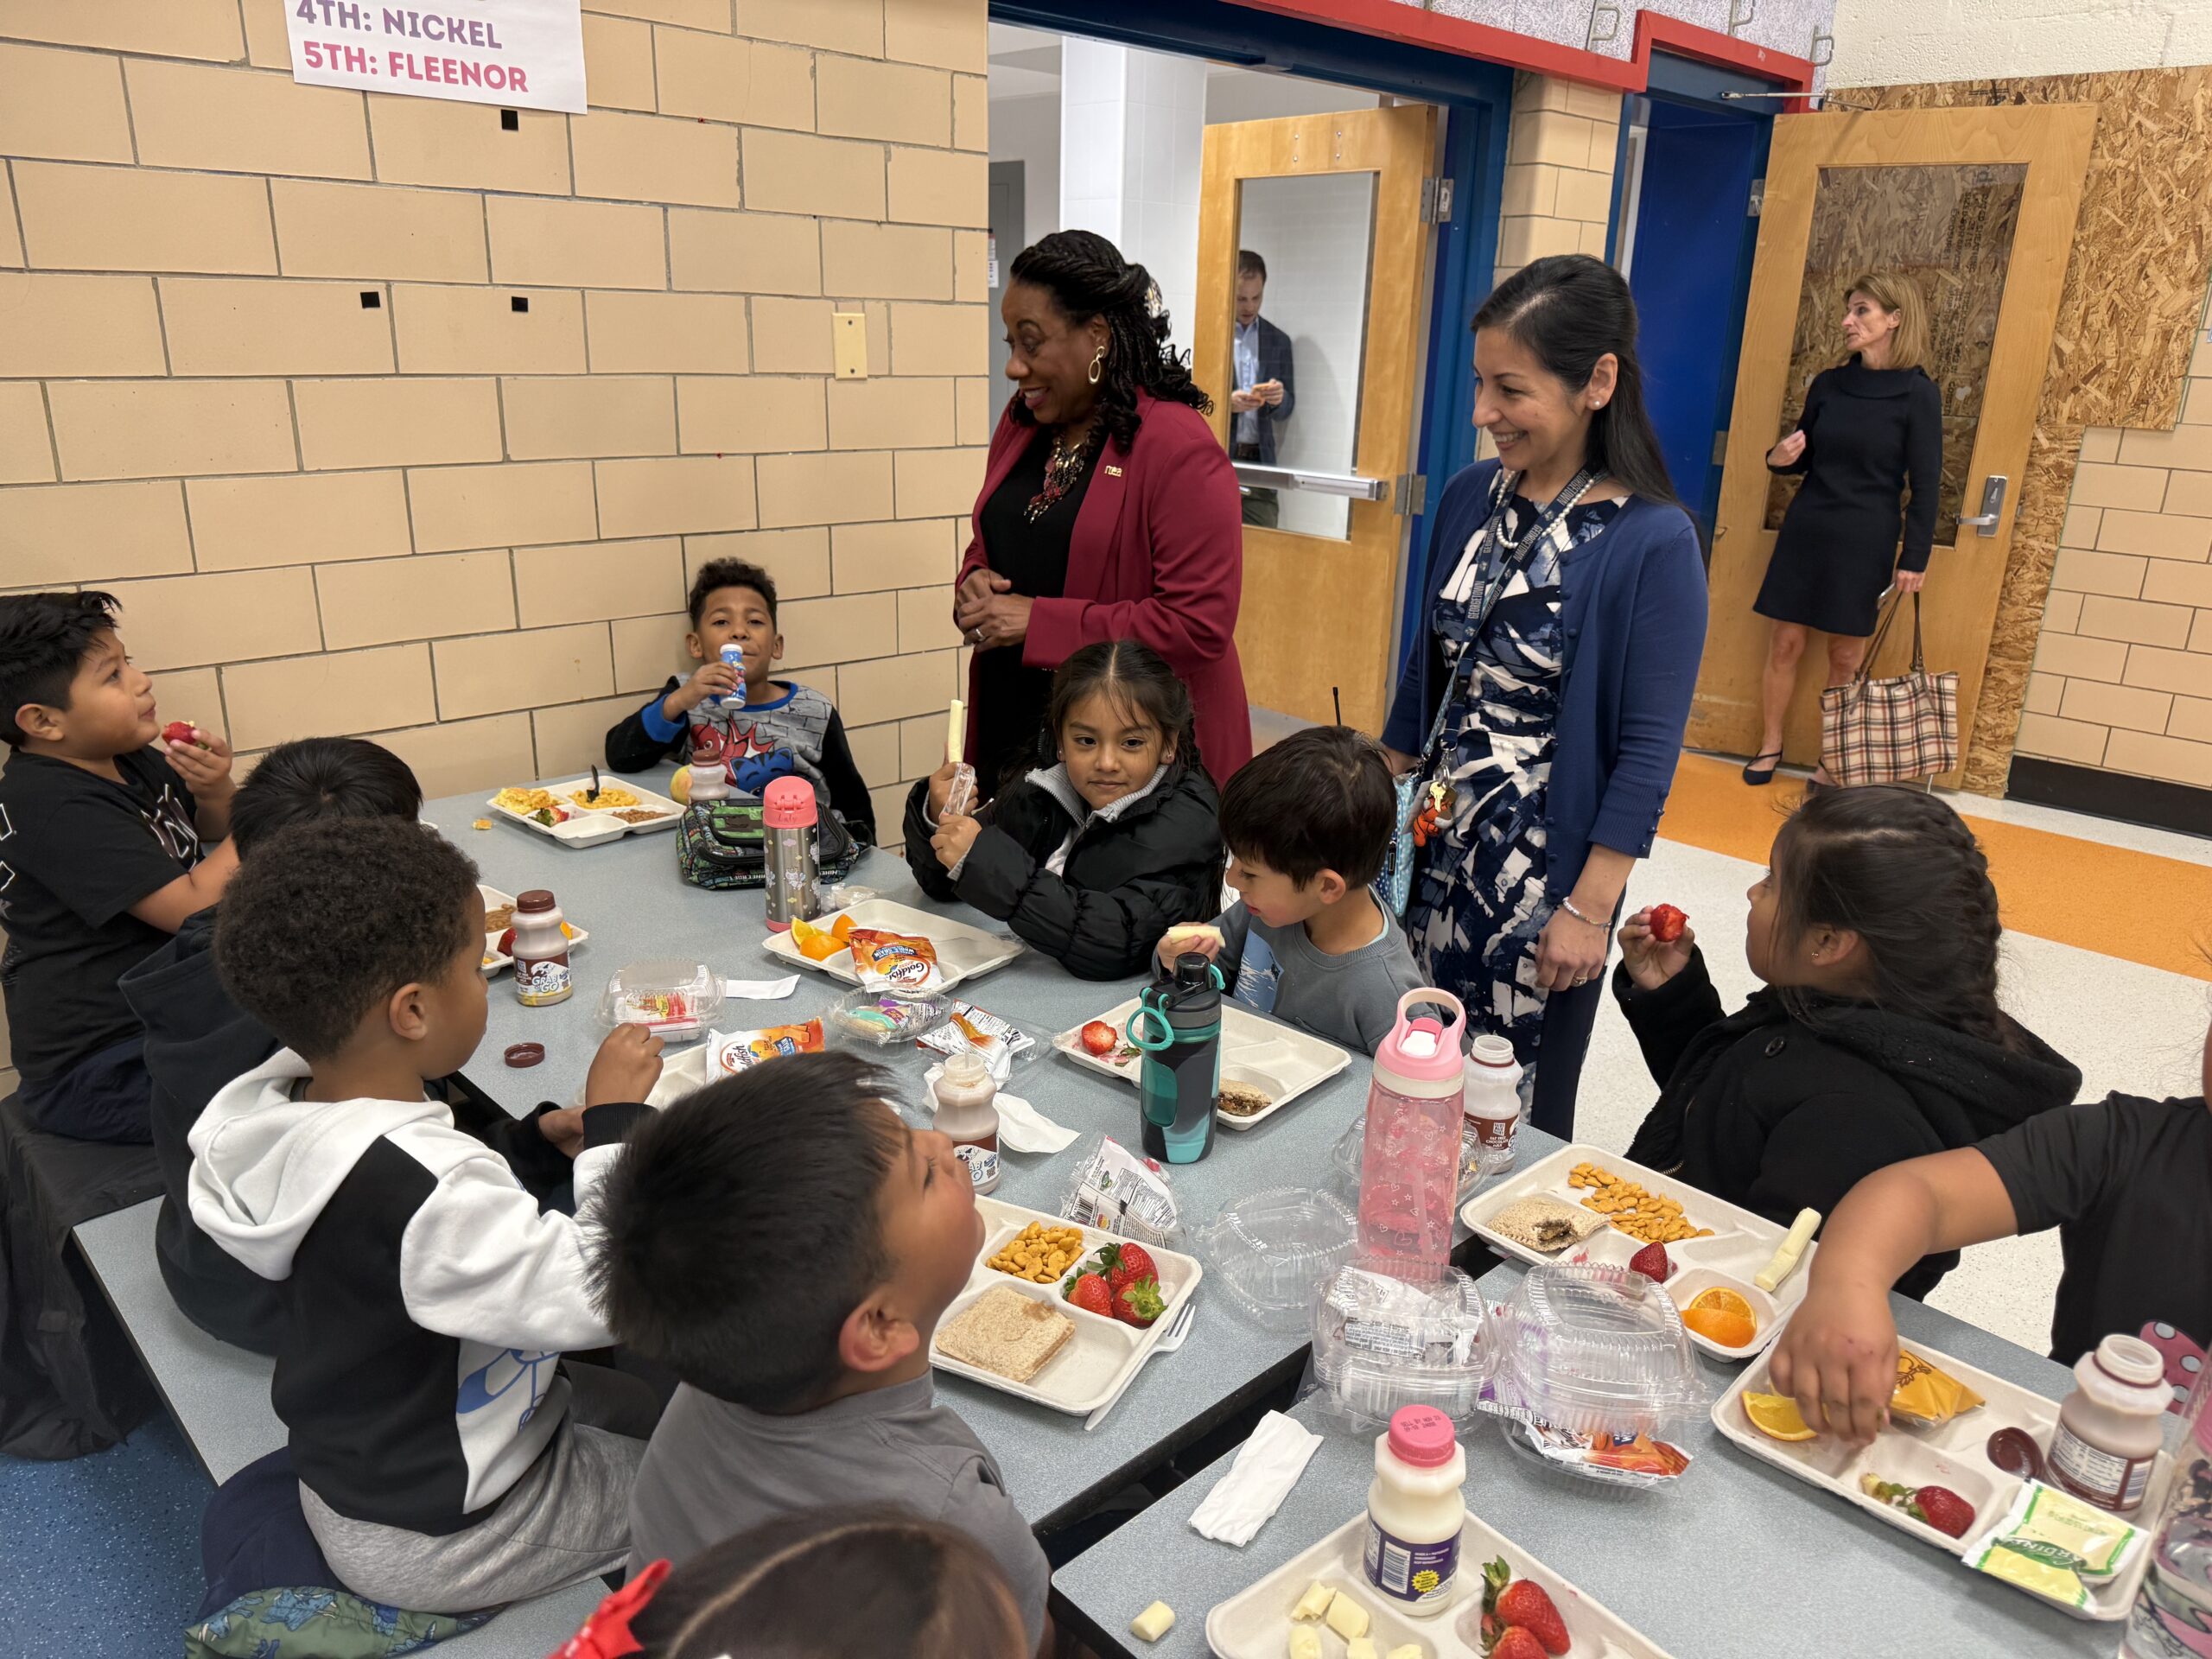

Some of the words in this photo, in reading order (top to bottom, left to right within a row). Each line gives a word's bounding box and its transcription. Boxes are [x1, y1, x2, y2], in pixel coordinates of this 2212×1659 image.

[296, 0, 372, 31] 4TH:
[382, 8, 503, 49] NICKEL
[304, 41, 378, 75] 5TH:
[388, 51, 529, 93] FLEENOR
[1556, 469, 1592, 506] GEORGETOWN
[1483, 516, 1502, 554] GEORGETOWN
[1512, 524, 1543, 563] GEORGETOWN
[1467, 580, 1485, 620] GEORGETOWN
[531, 974, 558, 986] GRAB
[540, 982, 560, 993] GO
[971, 1169, 983, 1181] O
